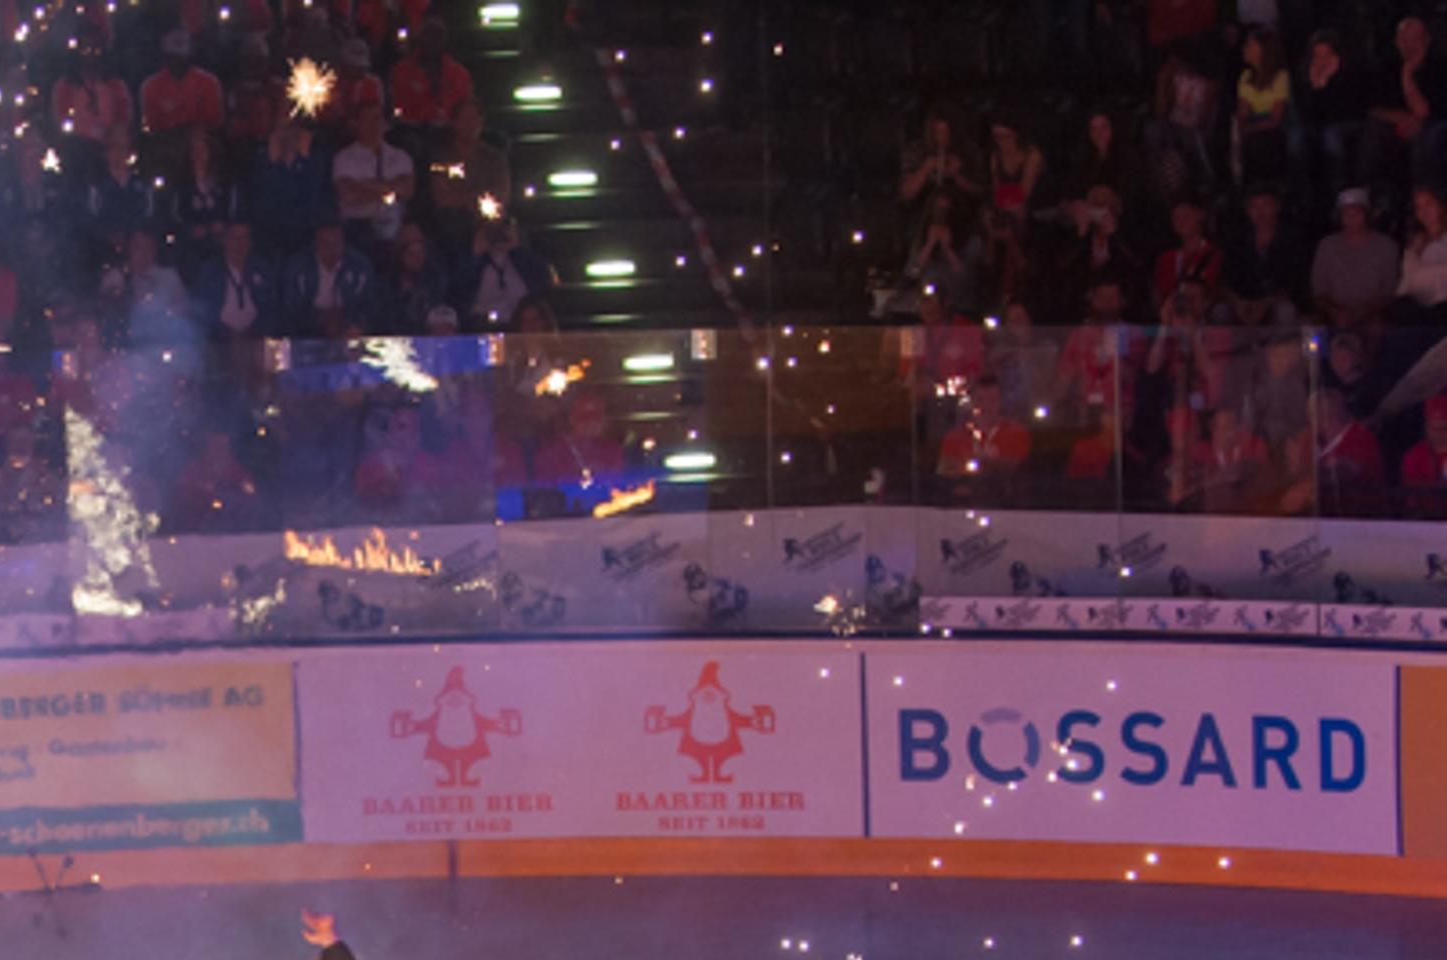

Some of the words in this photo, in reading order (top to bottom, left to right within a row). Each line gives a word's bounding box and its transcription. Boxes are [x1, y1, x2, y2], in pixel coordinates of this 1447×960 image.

[898, 708, 1367, 793] BOSSARD
[362, 793, 475, 815] BAARER
[487, 792, 553, 813] BIER
[616, 791, 727, 811] BAARER
[739, 791, 805, 811] BIER
